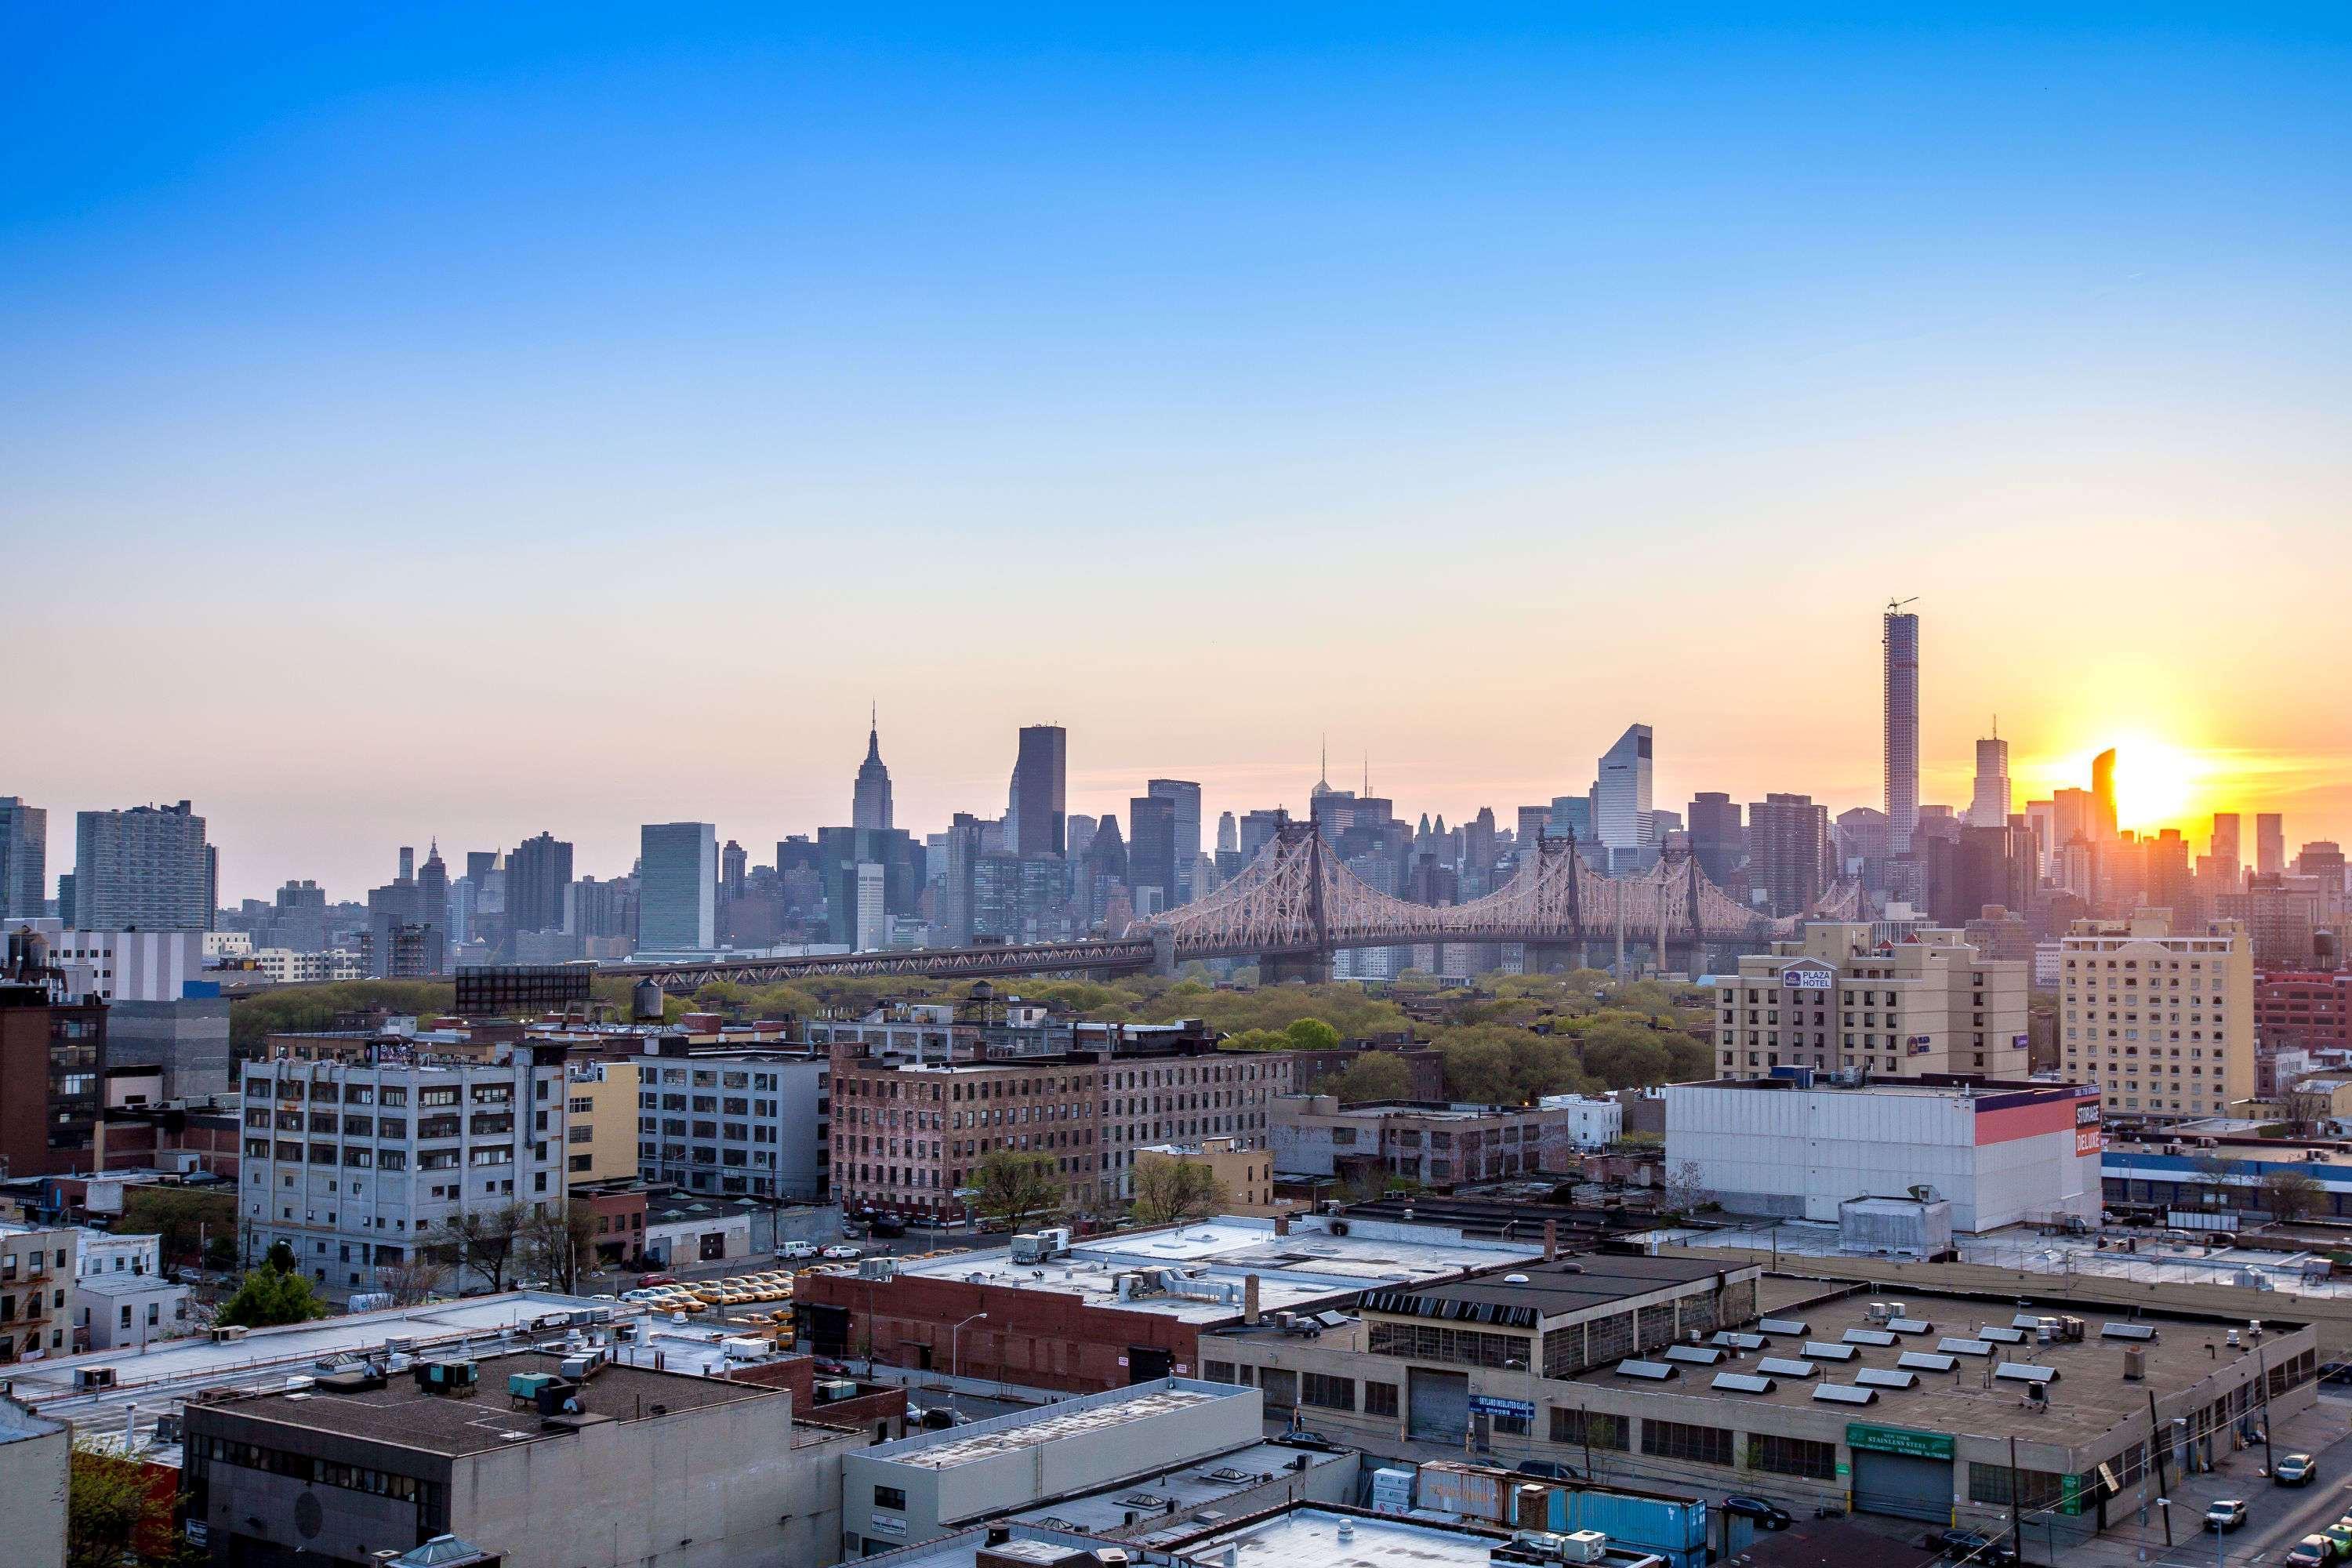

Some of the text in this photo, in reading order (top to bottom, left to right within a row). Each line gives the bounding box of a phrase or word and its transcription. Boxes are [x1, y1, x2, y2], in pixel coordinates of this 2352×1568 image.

[2078, 1105, 2099, 1124] STORAGE
[2077, 1131, 2100, 1151] DELUXE
[1497, 1399, 1516, 1410] INSULATED
[1868, 1436, 1905, 1446] STAINLESS
